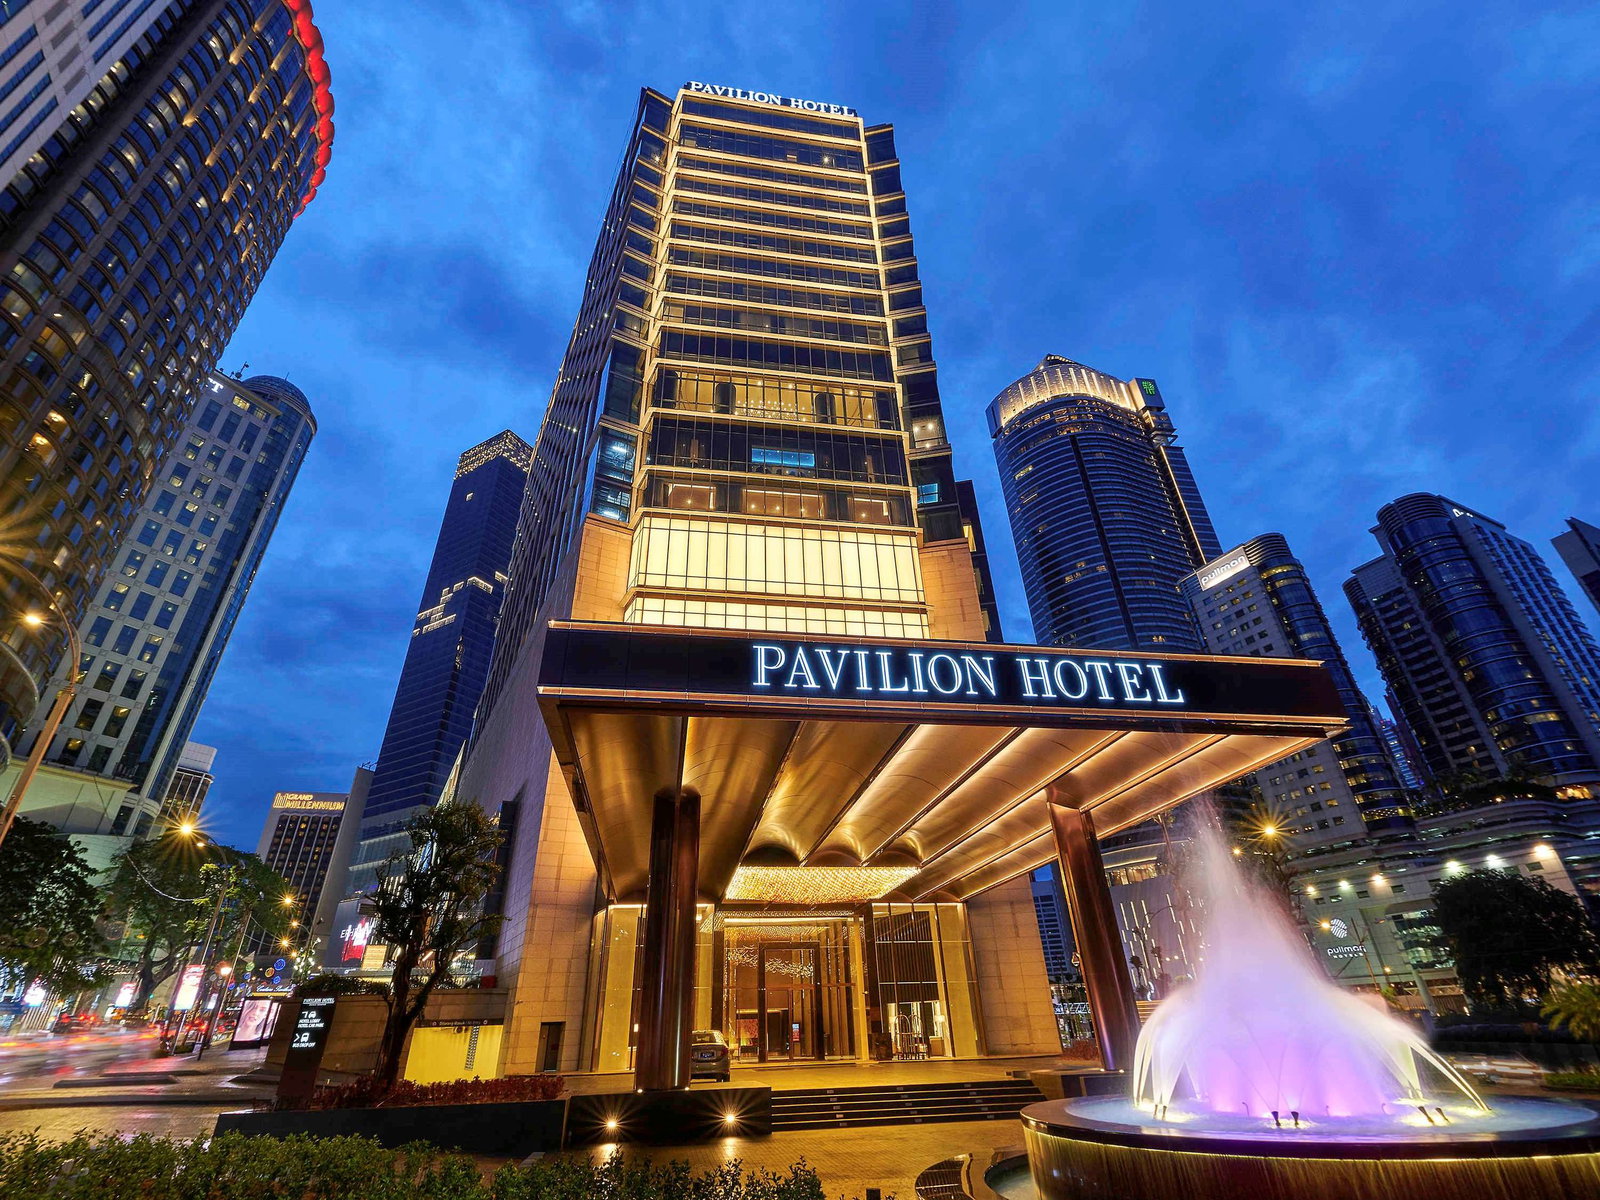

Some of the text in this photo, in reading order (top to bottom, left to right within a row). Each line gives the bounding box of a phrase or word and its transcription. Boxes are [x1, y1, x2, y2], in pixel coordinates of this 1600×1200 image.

[690, 80, 855, 117] PAVILION HOTEL
[1201, 555, 1245, 585] pullman
[752, 645, 1185, 703] PAVILION HOTEL
[285, 800, 345, 811] MILLENNIUM
[287, 793, 314, 801] GRAND
[1327, 945, 1367, 957] pullman
